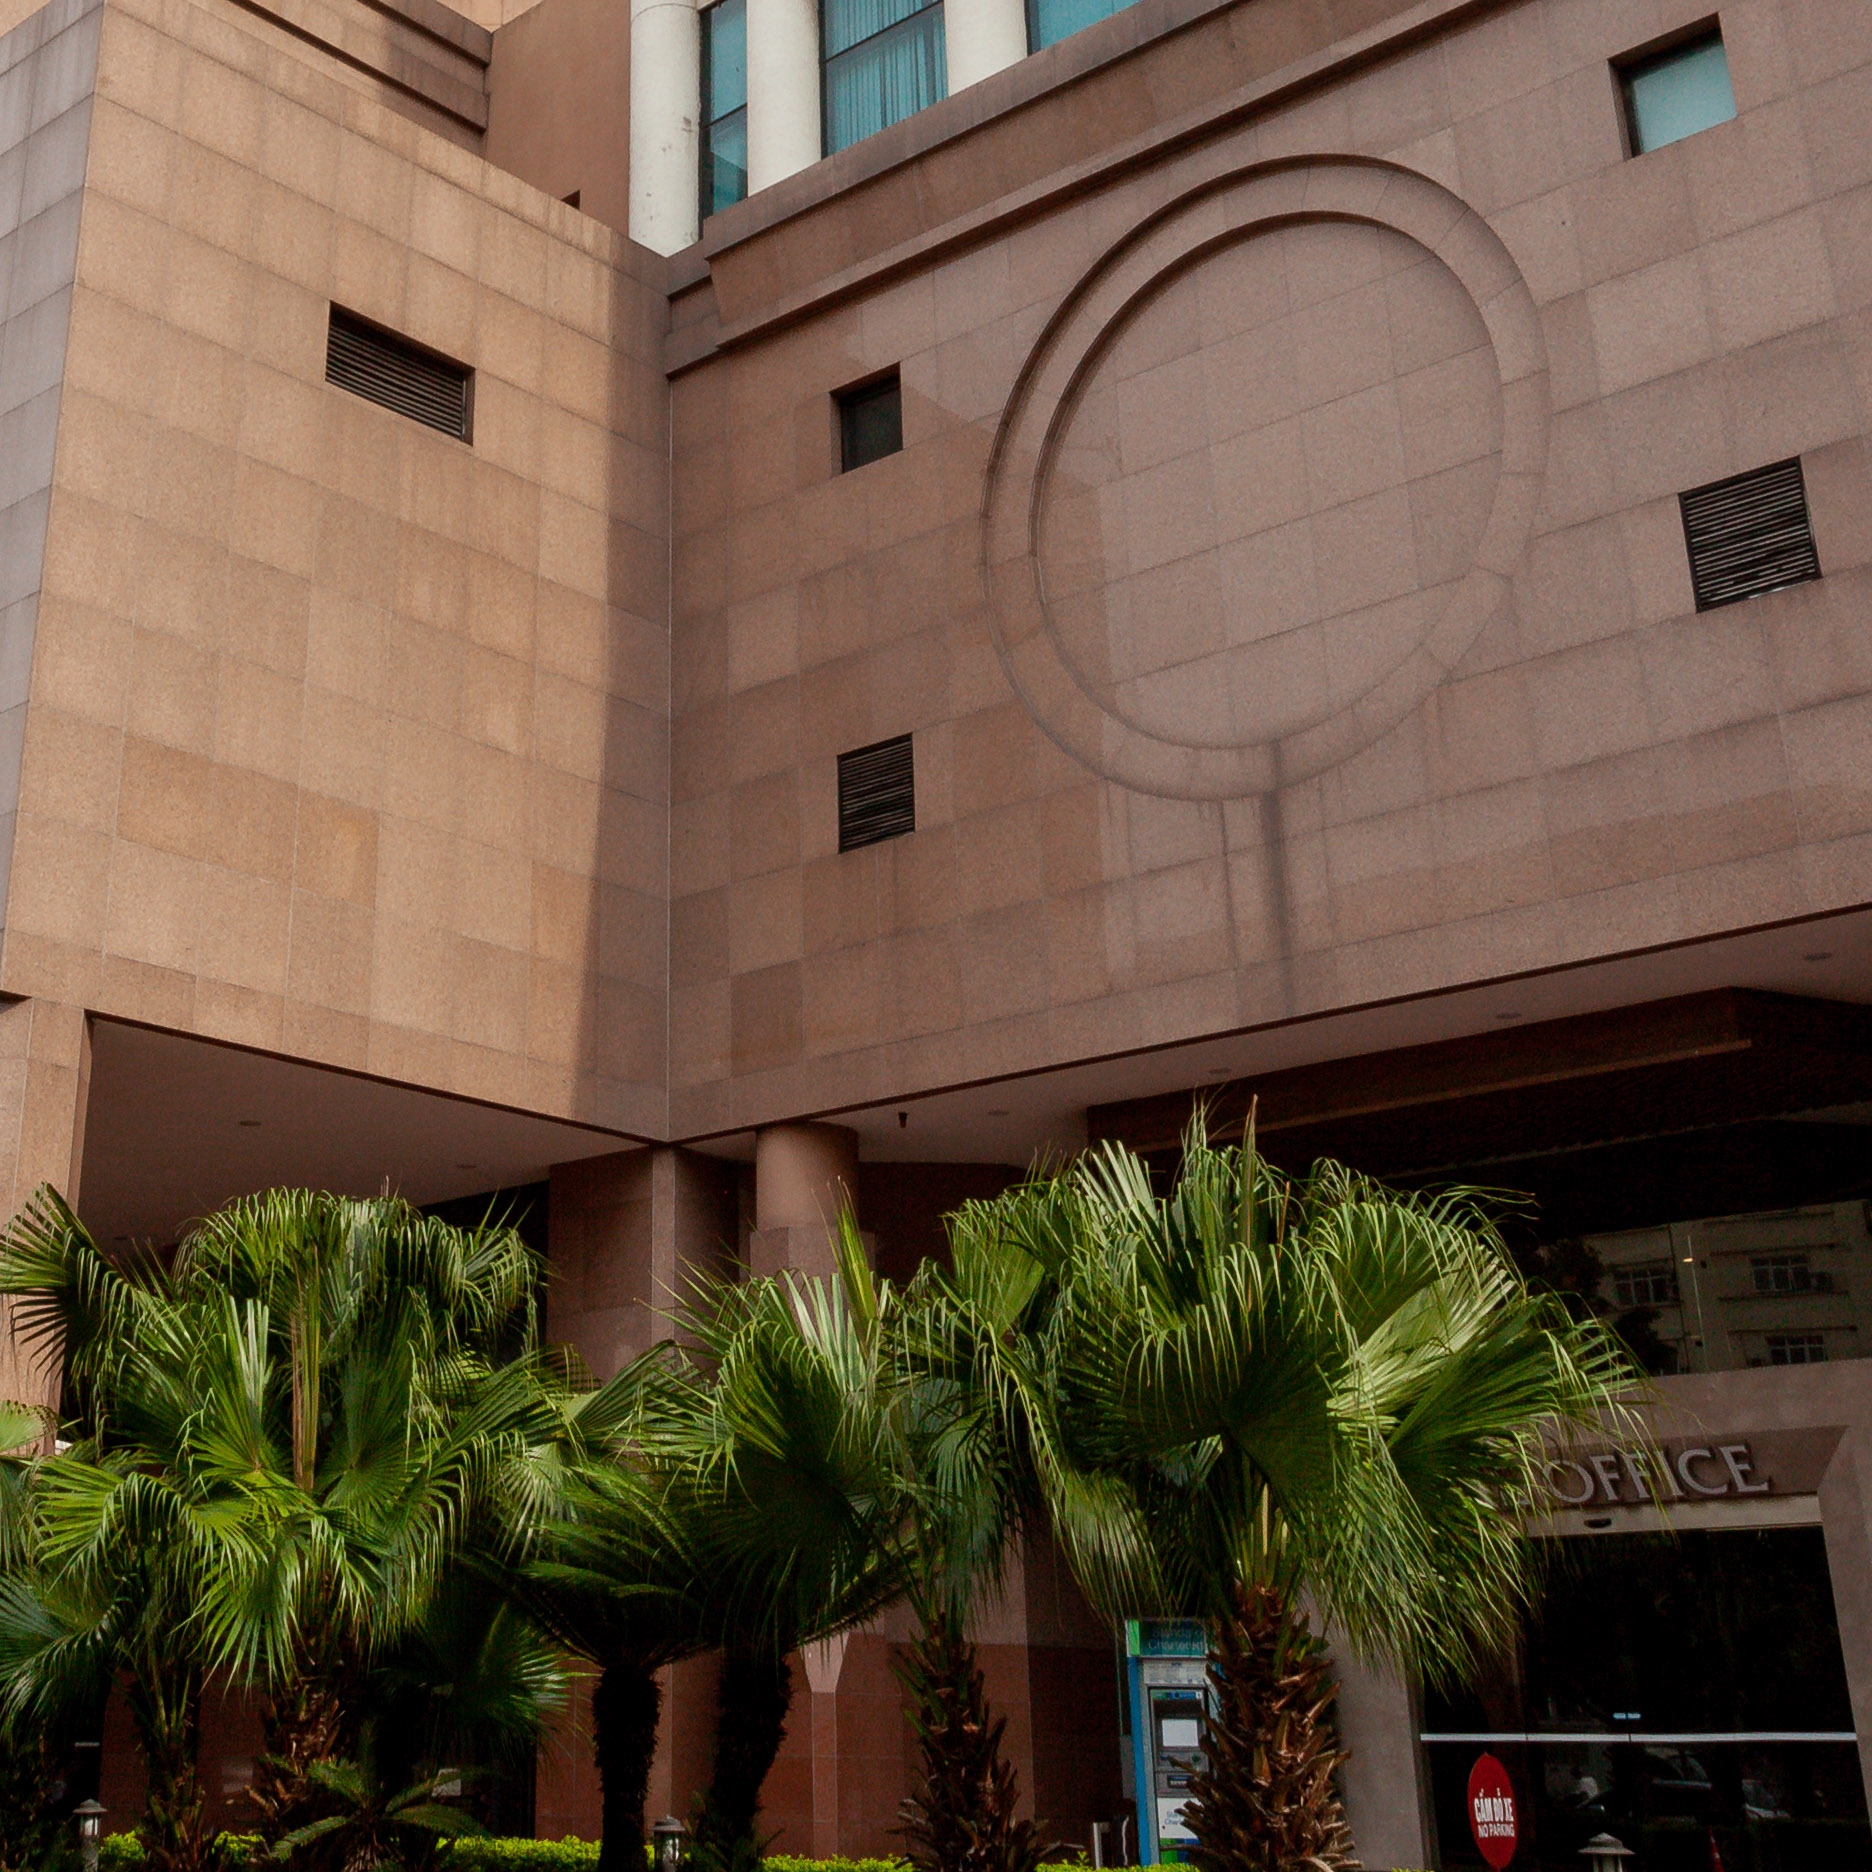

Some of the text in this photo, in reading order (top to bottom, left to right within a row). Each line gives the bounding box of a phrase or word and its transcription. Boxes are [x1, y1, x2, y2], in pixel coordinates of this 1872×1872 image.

[1543, 1444, 1770, 1503] OFFICE
[1478, 1823, 1515, 1838] NO PARKING
